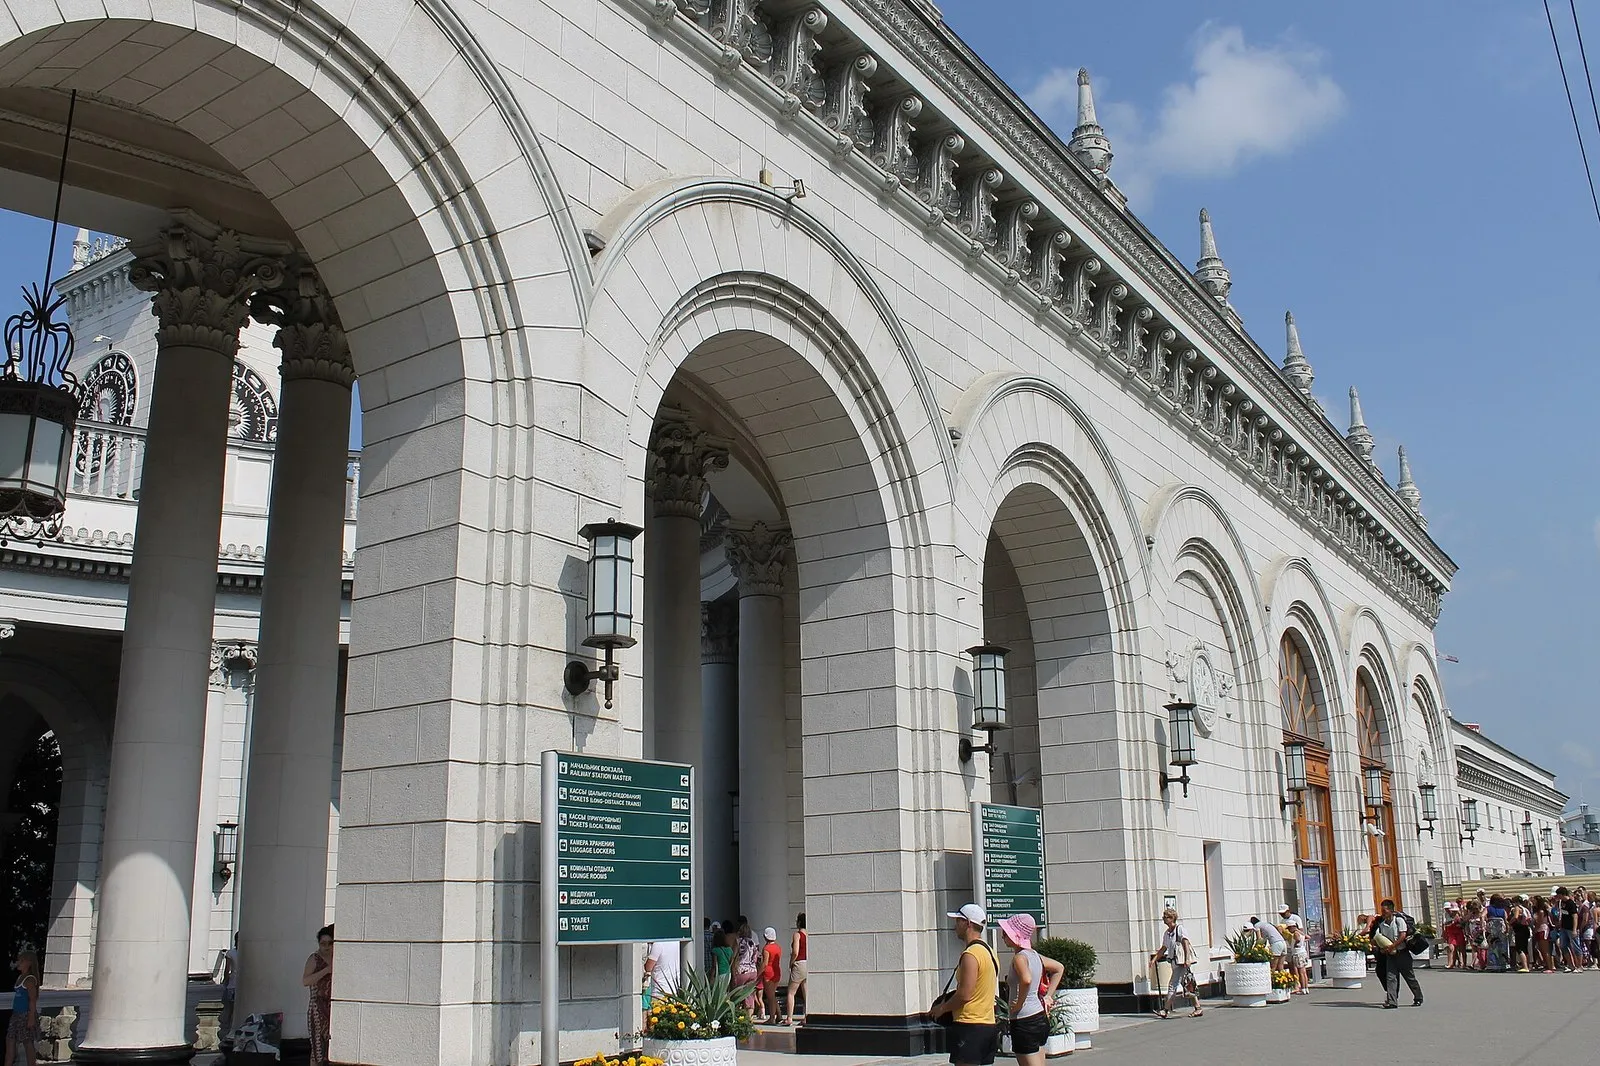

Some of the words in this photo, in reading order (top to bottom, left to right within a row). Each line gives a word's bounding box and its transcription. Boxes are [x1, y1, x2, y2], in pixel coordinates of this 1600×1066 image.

[570, 762, 600, 771] НАЧАЛЬНИК
[601, 766, 624, 774] ВОКЗАЛА
[592, 771, 612, 780] STATION
[612, 773, 632, 782] MASTER
[570, 787, 587, 795] КАССЫ
[570, 795, 589, 803] TICKETS
[570, 846, 593, 854] LUGGAGE
[593, 847, 616, 855] LOCKERS
[594, 865, 615, 873] ОТДЫХА
